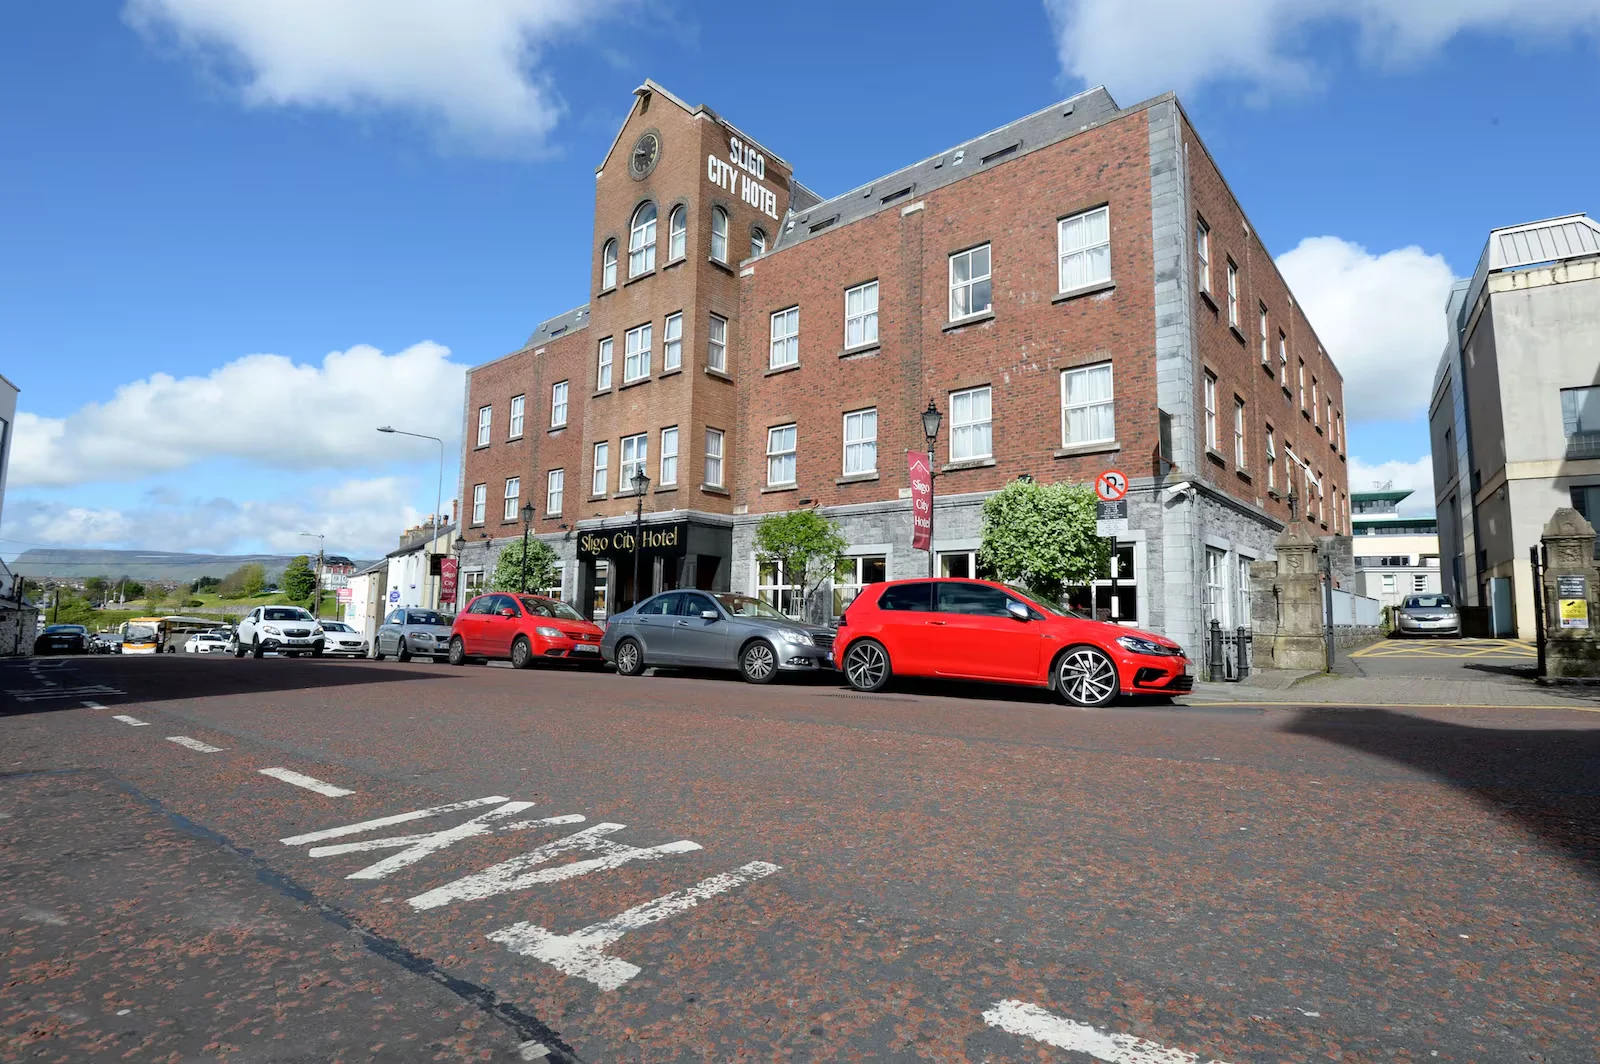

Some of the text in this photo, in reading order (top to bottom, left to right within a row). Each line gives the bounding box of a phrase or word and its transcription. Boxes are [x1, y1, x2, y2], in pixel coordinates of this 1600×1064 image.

[729, 136, 766, 181] SLIGO
[707, 154, 779, 221] CITY HOTEL
[912, 479, 930, 495] Sligo
[916, 498, 929, 514] City
[914, 515, 931, 529] Hotel
[580, 525, 679, 556] Sligo City Hotel
[279, 795, 782, 991] TAXI
